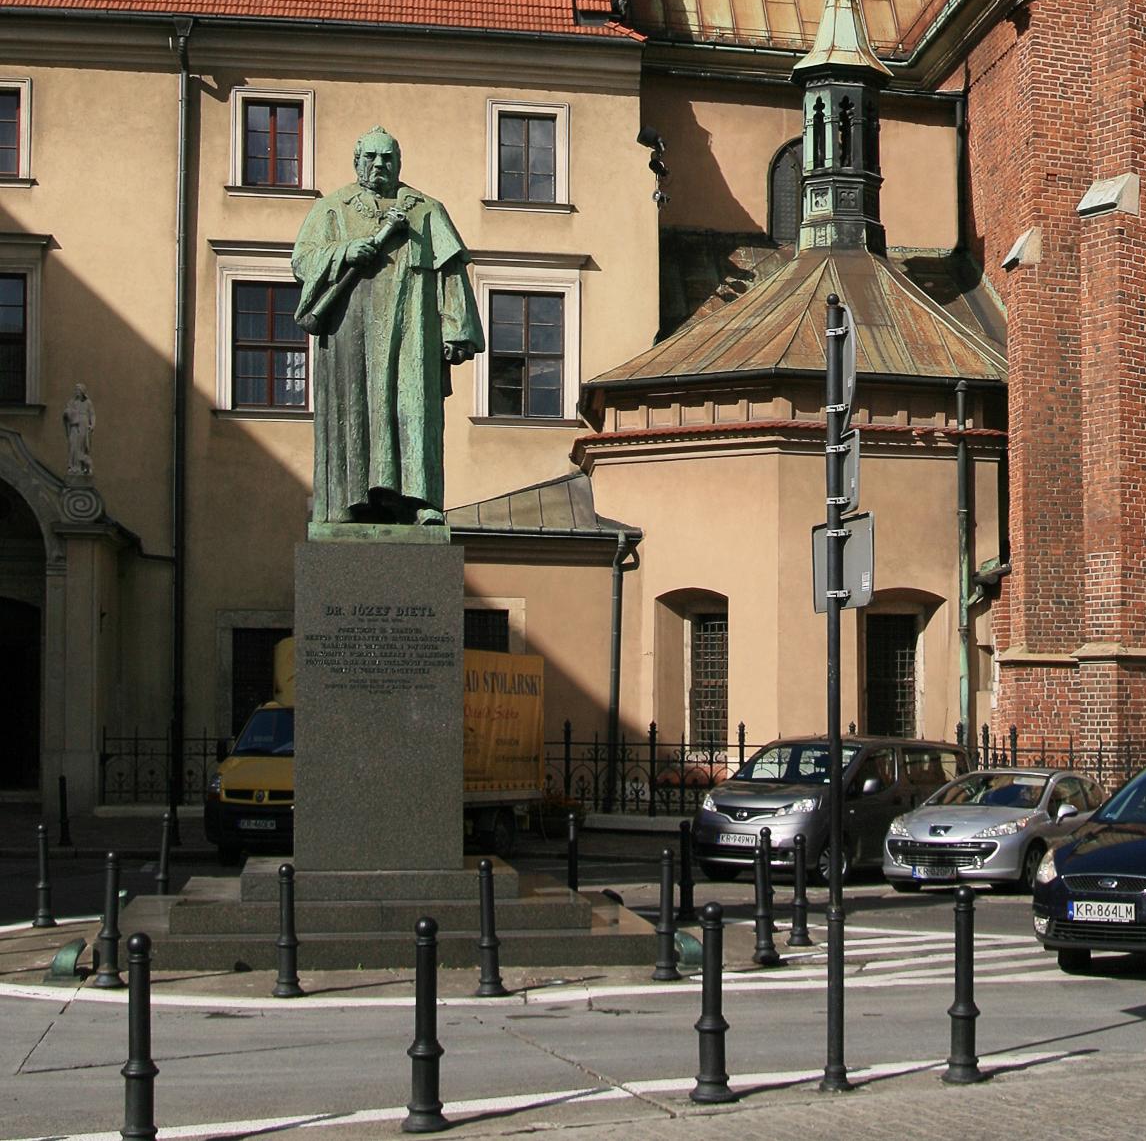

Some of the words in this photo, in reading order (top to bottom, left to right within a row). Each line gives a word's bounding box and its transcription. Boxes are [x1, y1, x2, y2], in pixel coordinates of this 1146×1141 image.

[326, 605, 346, 617] DR.
[351, 603, 392, 617] JÓZEF
[395, 605, 436, 618] DIETL
[1076, 903, 1093, 917] KR
[1097, 904, 1133, 919] 864LM
